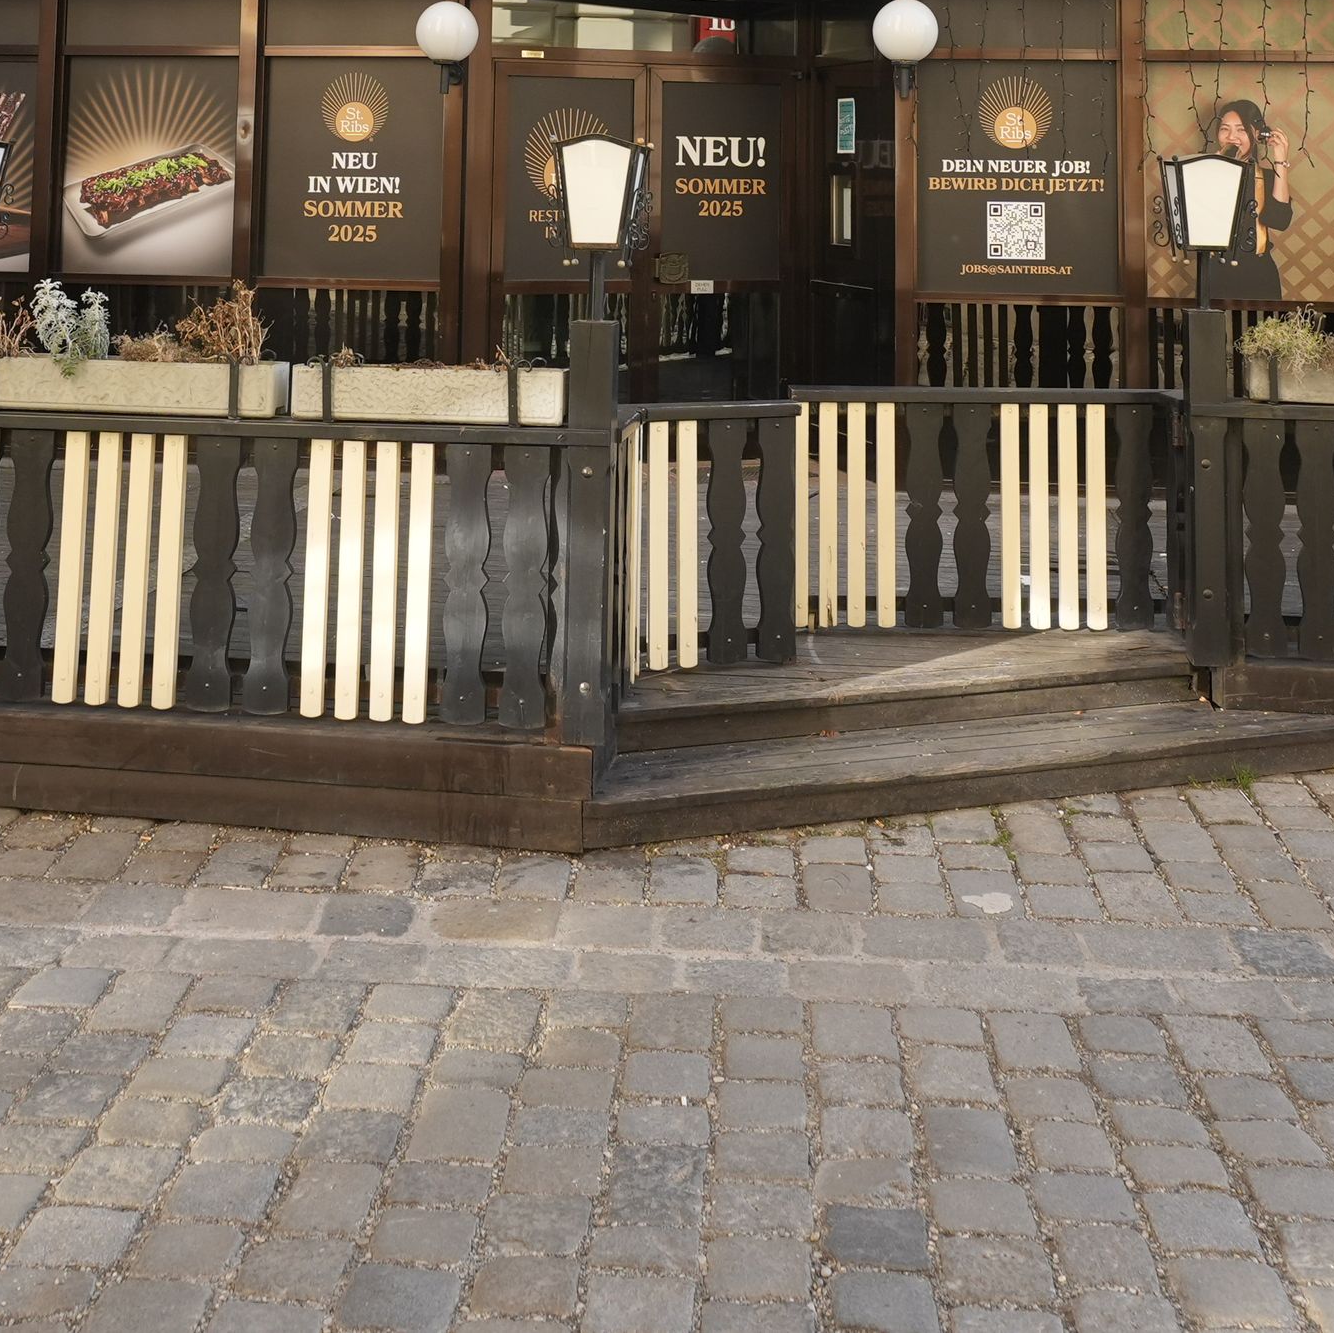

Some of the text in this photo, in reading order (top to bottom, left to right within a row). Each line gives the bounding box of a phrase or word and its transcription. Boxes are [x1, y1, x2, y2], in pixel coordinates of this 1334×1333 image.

[346, 107, 364, 120] St.
[1006, 112, 1023, 126] St
[340, 120, 370, 133] Ribs
[999, 126, 1032, 140] Ribs
[675, 135, 766, 168] NEU!
[331, 152, 378, 170] NEU
[942, 159, 1090, 177] DEIN NEUER JOB!
[308, 176, 400, 194] IN WIEN!
[675, 177, 766, 195] SOMMER
[928, 177, 1105, 195] BEWIRB DICH JETZT!
[303, 199, 404, 218] SOMMER
[529, 209, 559, 222] REST
[698, 200, 743, 217] 2025
[328, 224, 378, 242] 2025
[960, 264, 1073, 276] JOBS@SAINTRIBS.AT
